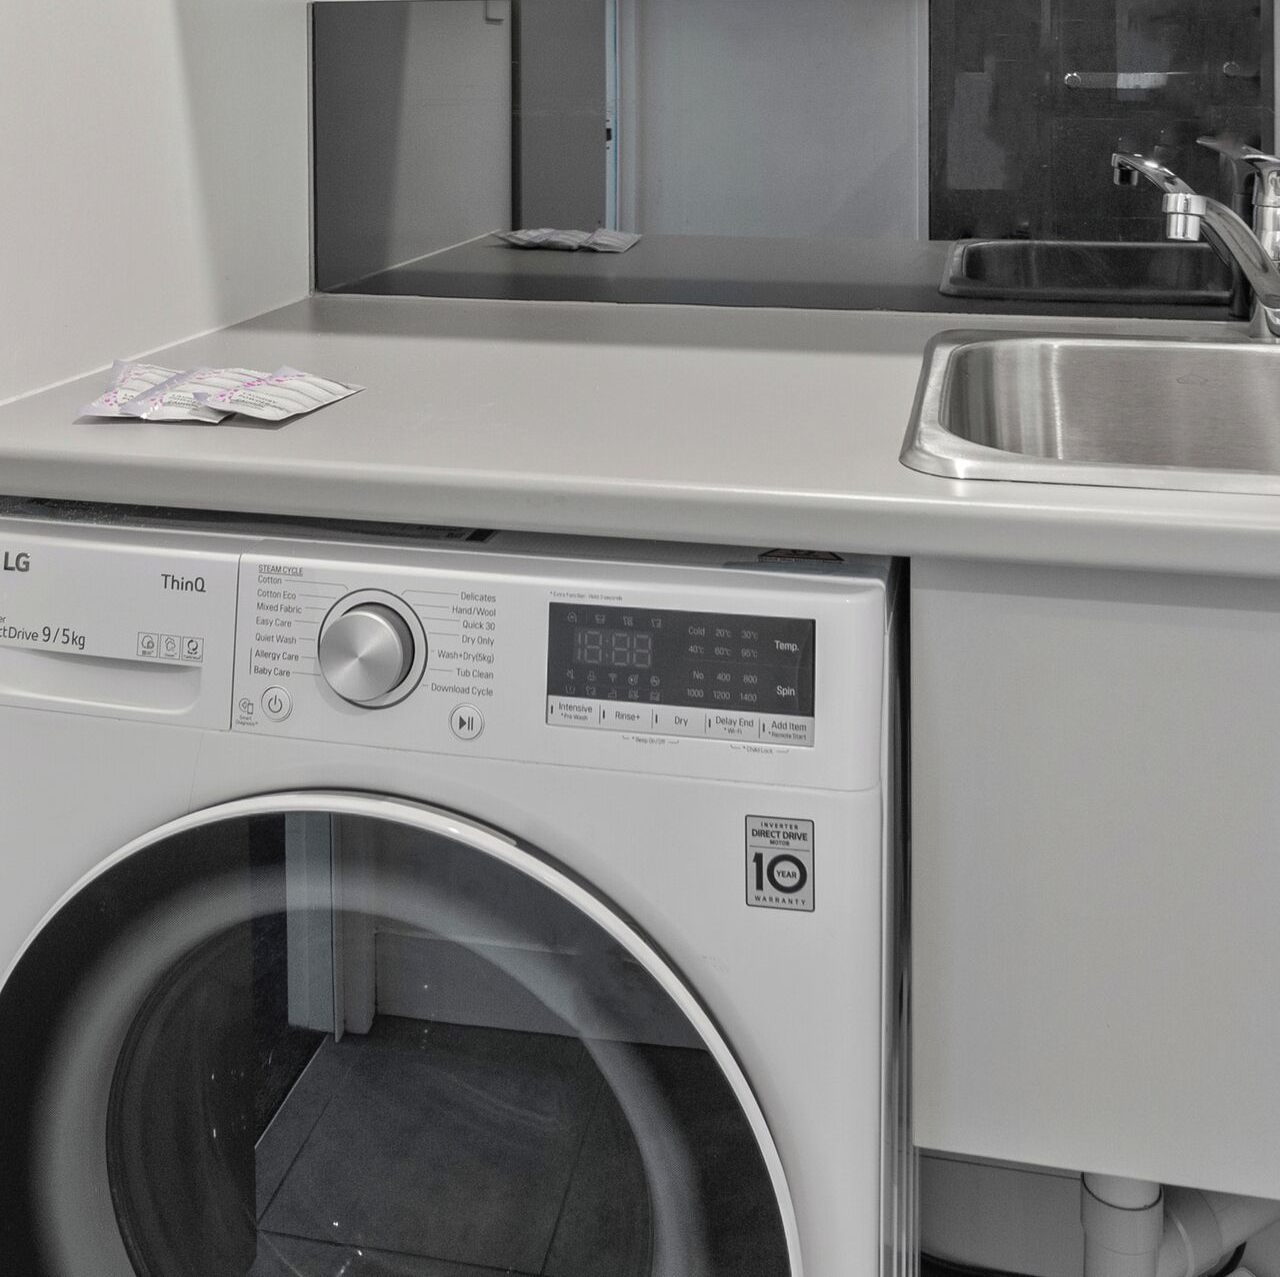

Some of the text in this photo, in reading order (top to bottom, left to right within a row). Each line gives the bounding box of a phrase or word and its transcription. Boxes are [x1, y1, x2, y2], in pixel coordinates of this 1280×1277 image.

[4, 552, 31, 572] LG
[259, 564, 303, 576] STEAM CYCLE
[161, 574, 206, 592] ThinQ
[258, 575, 282, 584] Cotton
[257, 589, 296, 600] Cotton Eco
[460, 591, 496, 603] Delicates
[256, 602, 302, 614] Mixed Fabric
[451, 605, 496, 617] Hand/Wool
[256, 616, 292, 628] Easy Care
[462, 619, 496, 631] Quick 30
[688, 626, 705, 636] Cold
[255, 633, 297, 644] Quiet Wash
[461, 634, 495, 647] Dry Only
[774, 639, 800, 653] Temp.
[254, 649, 299, 661] Allergy Care
[253, 665, 291, 677] Baby Care
[456, 667, 494, 679] Tub Clean
[692, 670, 758, 684] No 400 800
[431, 682, 494, 697] Download Cycle
[686, 688, 757, 702] 1000 1200 1400
[776, 685, 796, 698] Spin
[558, 702, 593, 713] Intensive
[614, 711, 640, 722] Rinse+
[674, 715, 689, 727] Dry
[715, 716, 754, 727] Delay End
[771, 720, 807, 732] Add Item
[760, 821, 798, 830] INVERTER
[751, 828, 808, 842] DIRECT DRIVE
[752, 851, 807, 894] 10
[776, 869, 797, 879] YEAR
[754, 895, 806, 906] WARRANTY
